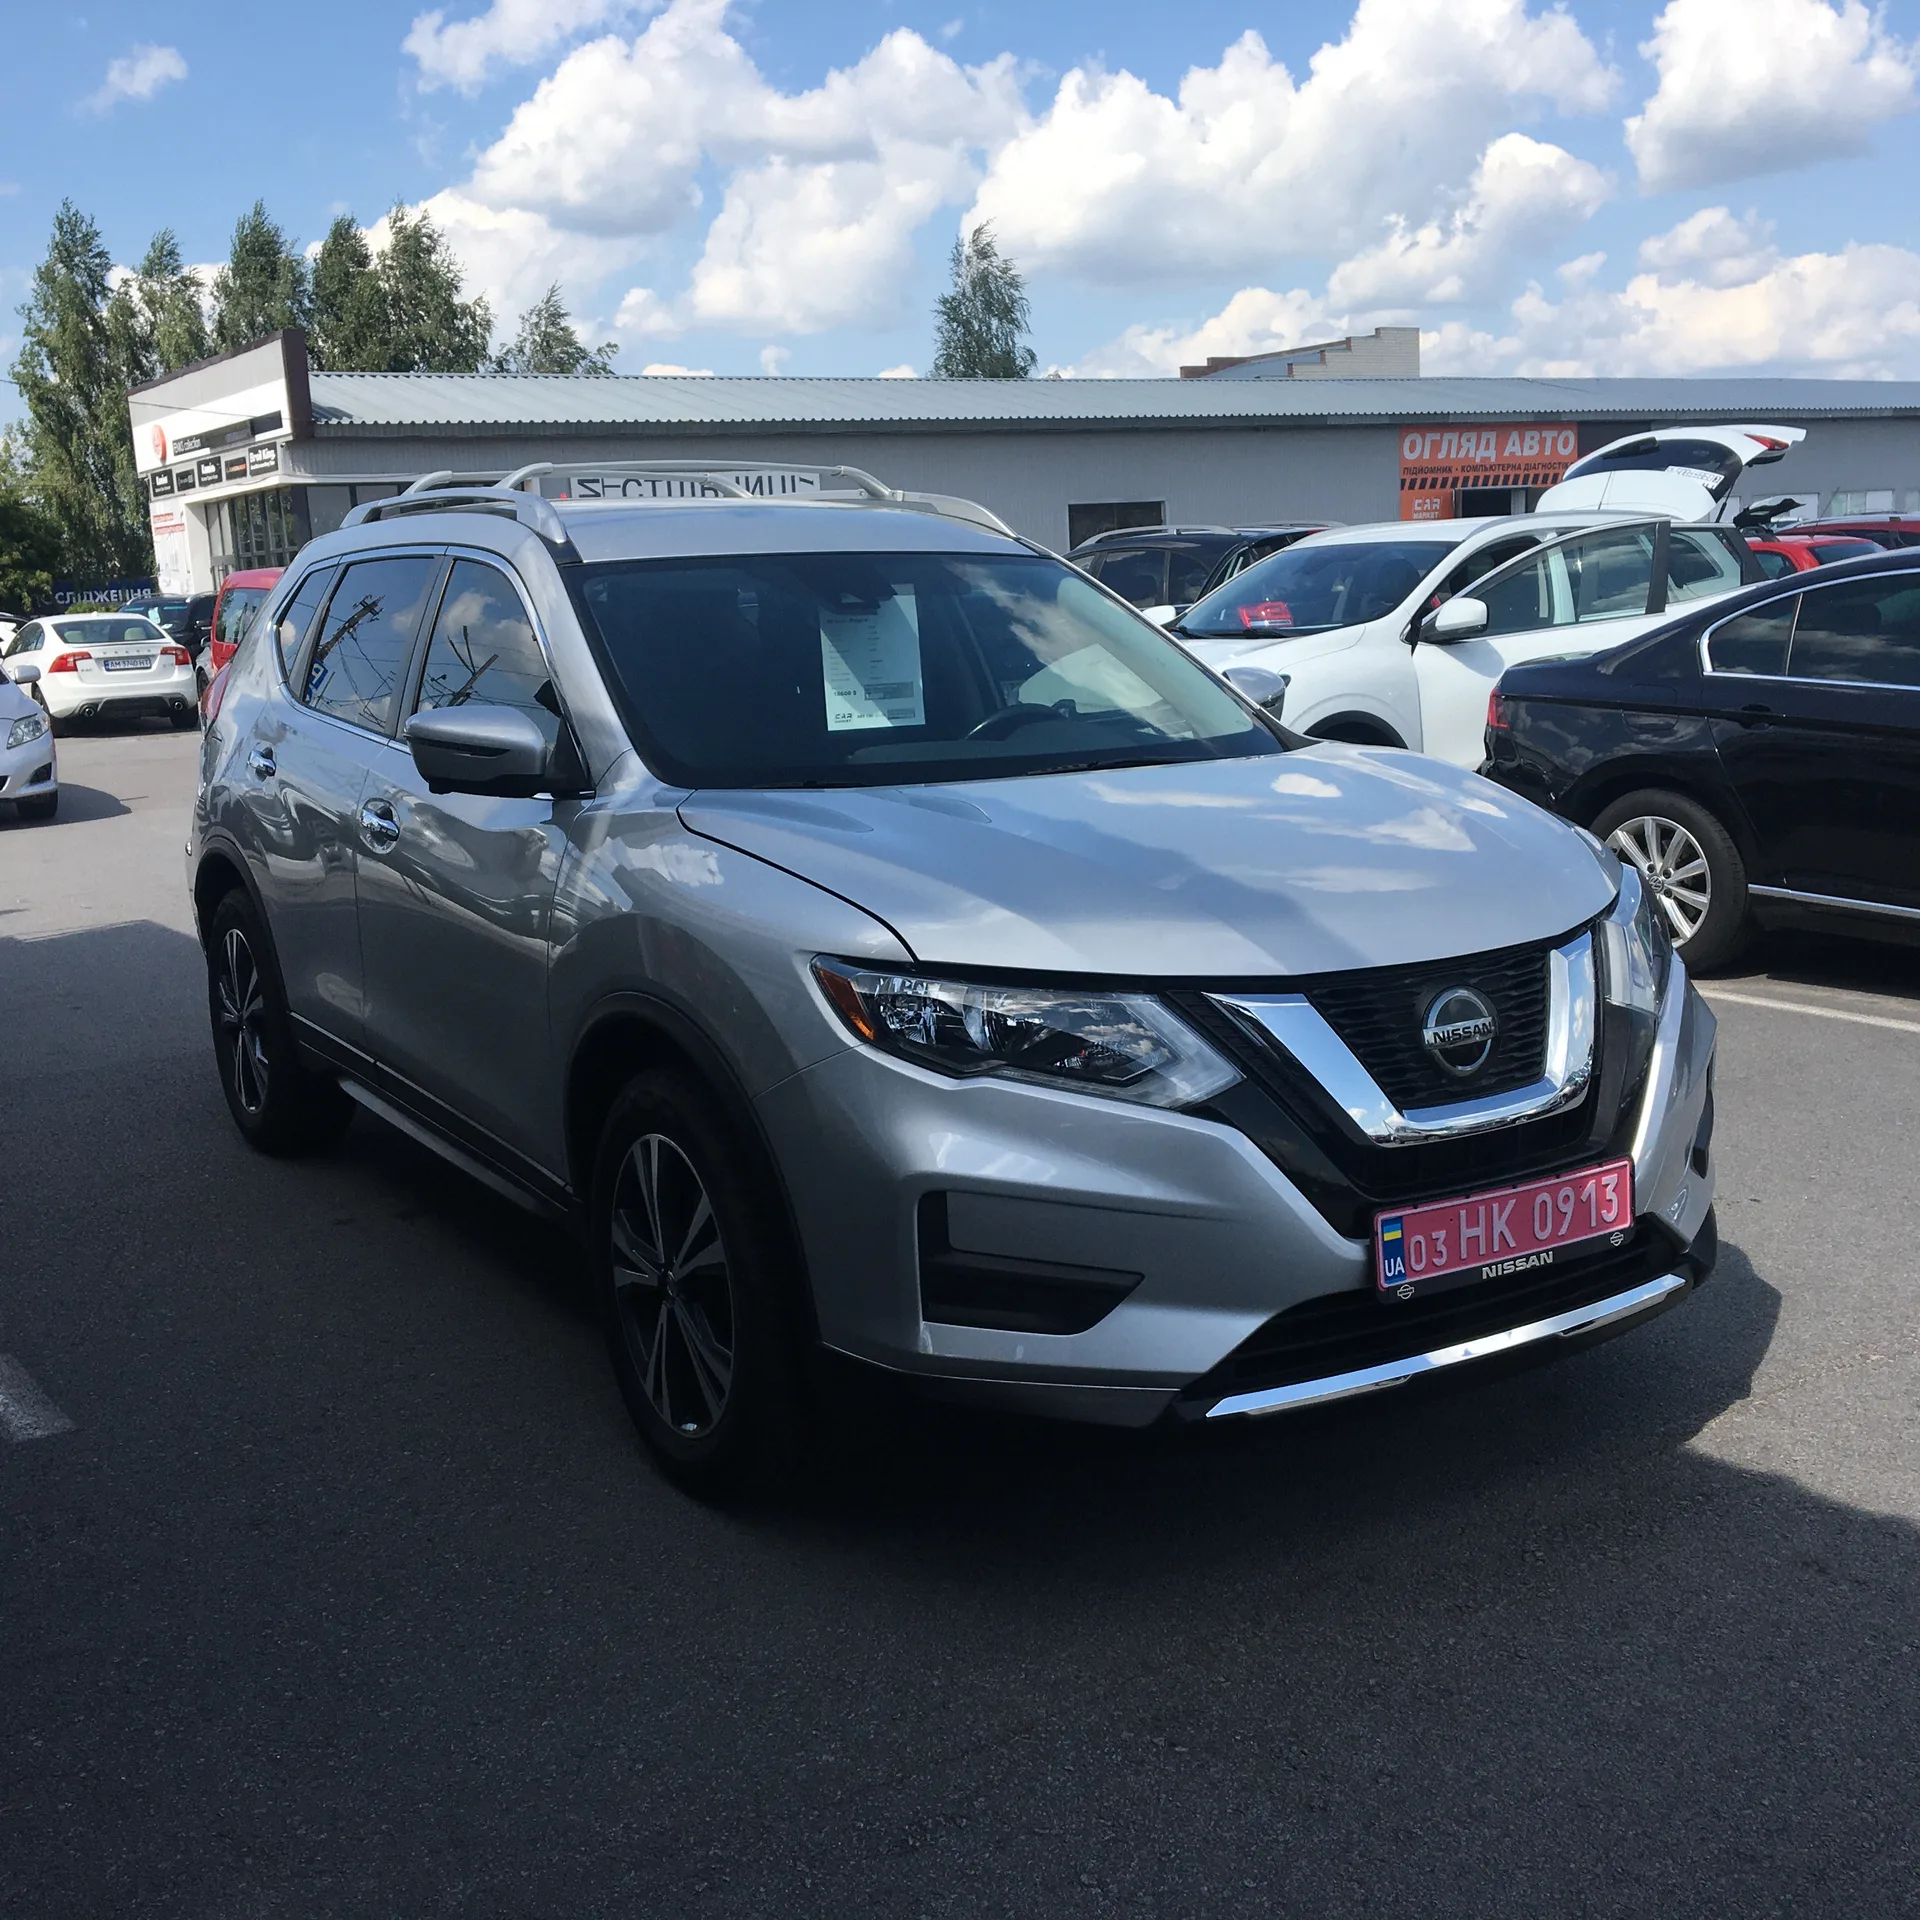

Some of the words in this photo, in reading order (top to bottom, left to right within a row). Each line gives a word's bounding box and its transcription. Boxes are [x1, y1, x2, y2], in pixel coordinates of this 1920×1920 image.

[1403, 431, 1497, 462] ОГЛЯД
[1504, 429, 1576, 457] АВТО
[1403, 465, 1453, 476] ПІДЙОМНИК
[1461, 463, 1522, 473] КОМПЬЮТЕРНА
[1414, 498, 1441, 511] CAR
[1432, 1021, 1492, 1044] NISSAN
[1409, 1230, 1448, 1272] 03
[1459, 1198, 1517, 1260] HK
[1533, 1173, 1619, 1241] 0913
[1384, 1257, 1405, 1278] UA
[1481, 1251, 1554, 1280] NISSAN
